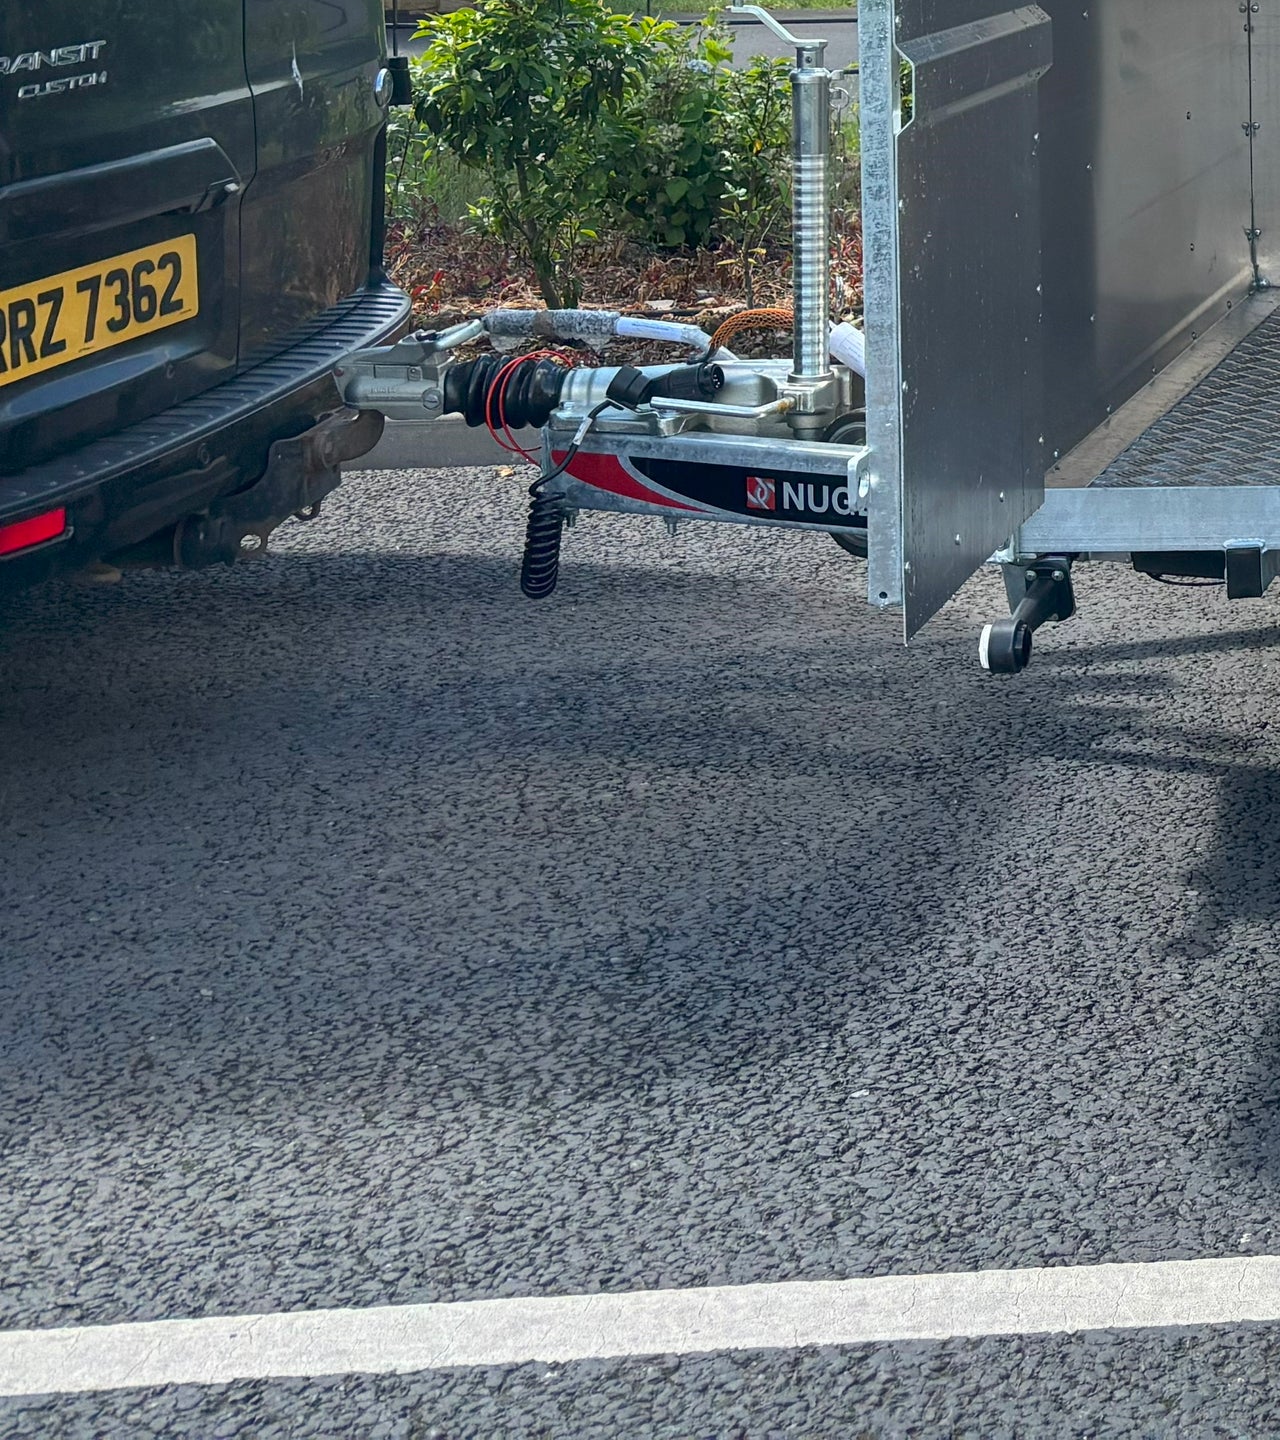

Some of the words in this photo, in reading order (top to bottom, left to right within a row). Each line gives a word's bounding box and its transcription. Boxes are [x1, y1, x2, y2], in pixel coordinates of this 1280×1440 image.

[17, 69, 108, 98] CUSTOM
[0, 286, 67, 373] RZ
[75, 250, 184, 343] 7362
[782, 481, 868, 517] NUG
